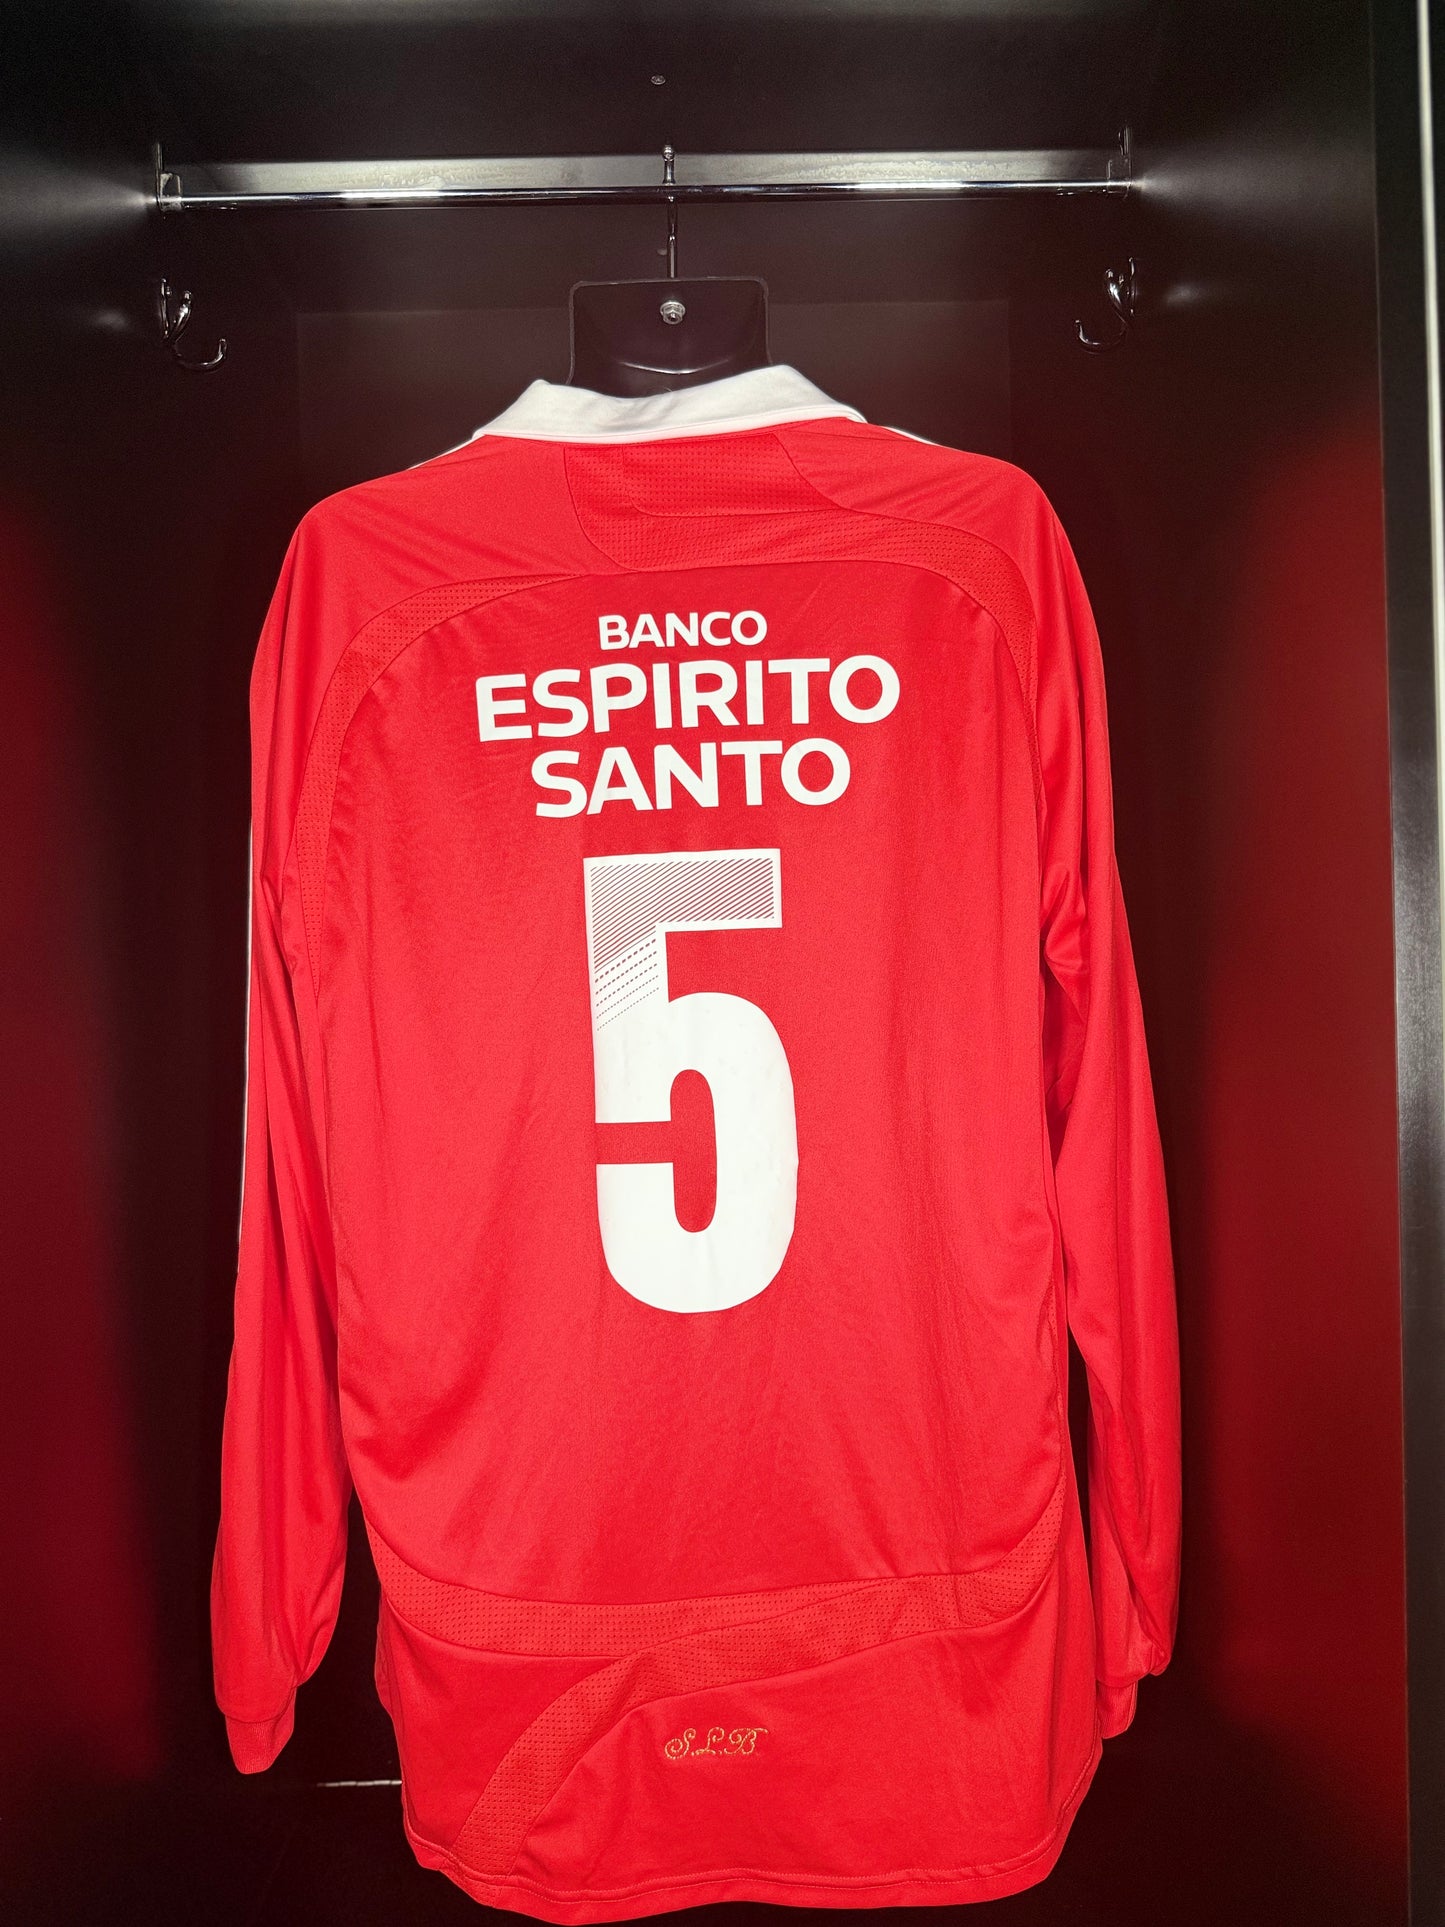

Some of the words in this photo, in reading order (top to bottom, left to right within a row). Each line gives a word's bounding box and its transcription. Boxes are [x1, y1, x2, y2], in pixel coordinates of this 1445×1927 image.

[598, 610, 768, 651] BANCO
[475, 654, 901, 742] ESPIRITO
[530, 737, 852, 819] SANTO
[583, 847, 800, 1314] 5
